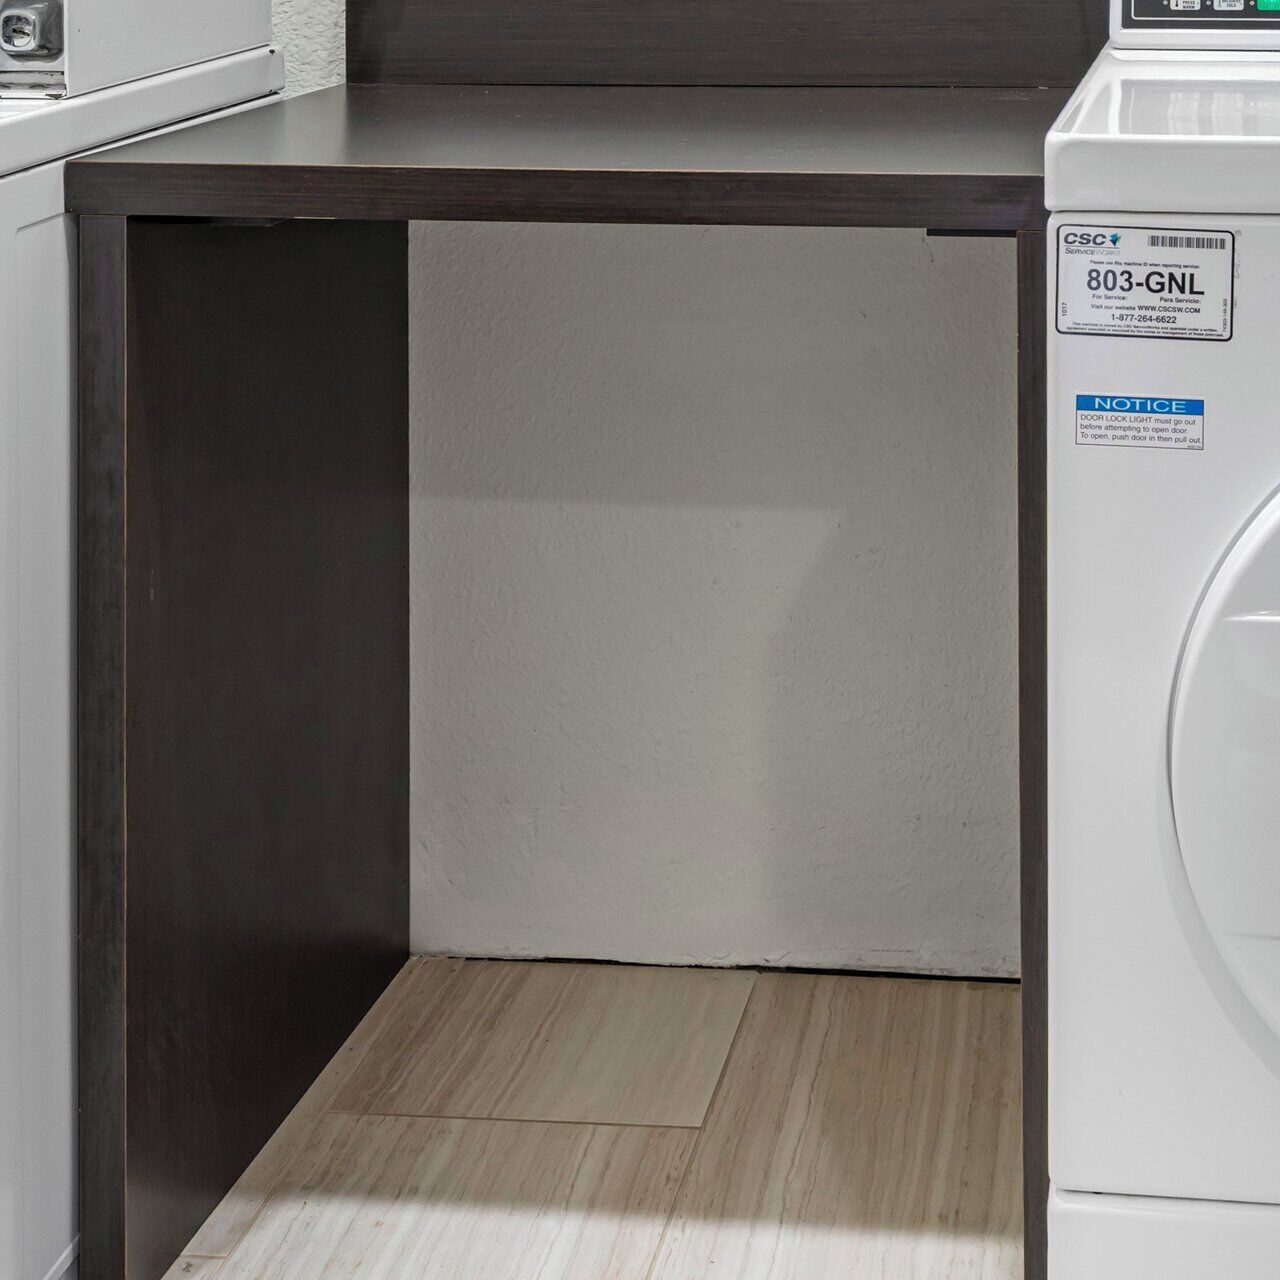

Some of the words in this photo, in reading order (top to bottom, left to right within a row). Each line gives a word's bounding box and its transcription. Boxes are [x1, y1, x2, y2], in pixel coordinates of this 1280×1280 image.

[1063, 232, 1107, 246] CSC
[1086, 268, 1205, 295] 803-GNL
[1111, 313, 1177, 324] 1-877-264-6622
[1094, 397, 1187, 413] NOTICE
[1080, 413, 1104, 421] DOOR
[1105, 414, 1127, 422] LOCK
[1104, 424, 1141, 433] attempting
[1151, 427, 1170, 435] open
[1080, 431, 1089, 439] To
[1111, 434, 1129, 442] push
[1174, 436, 1188, 444] pull
